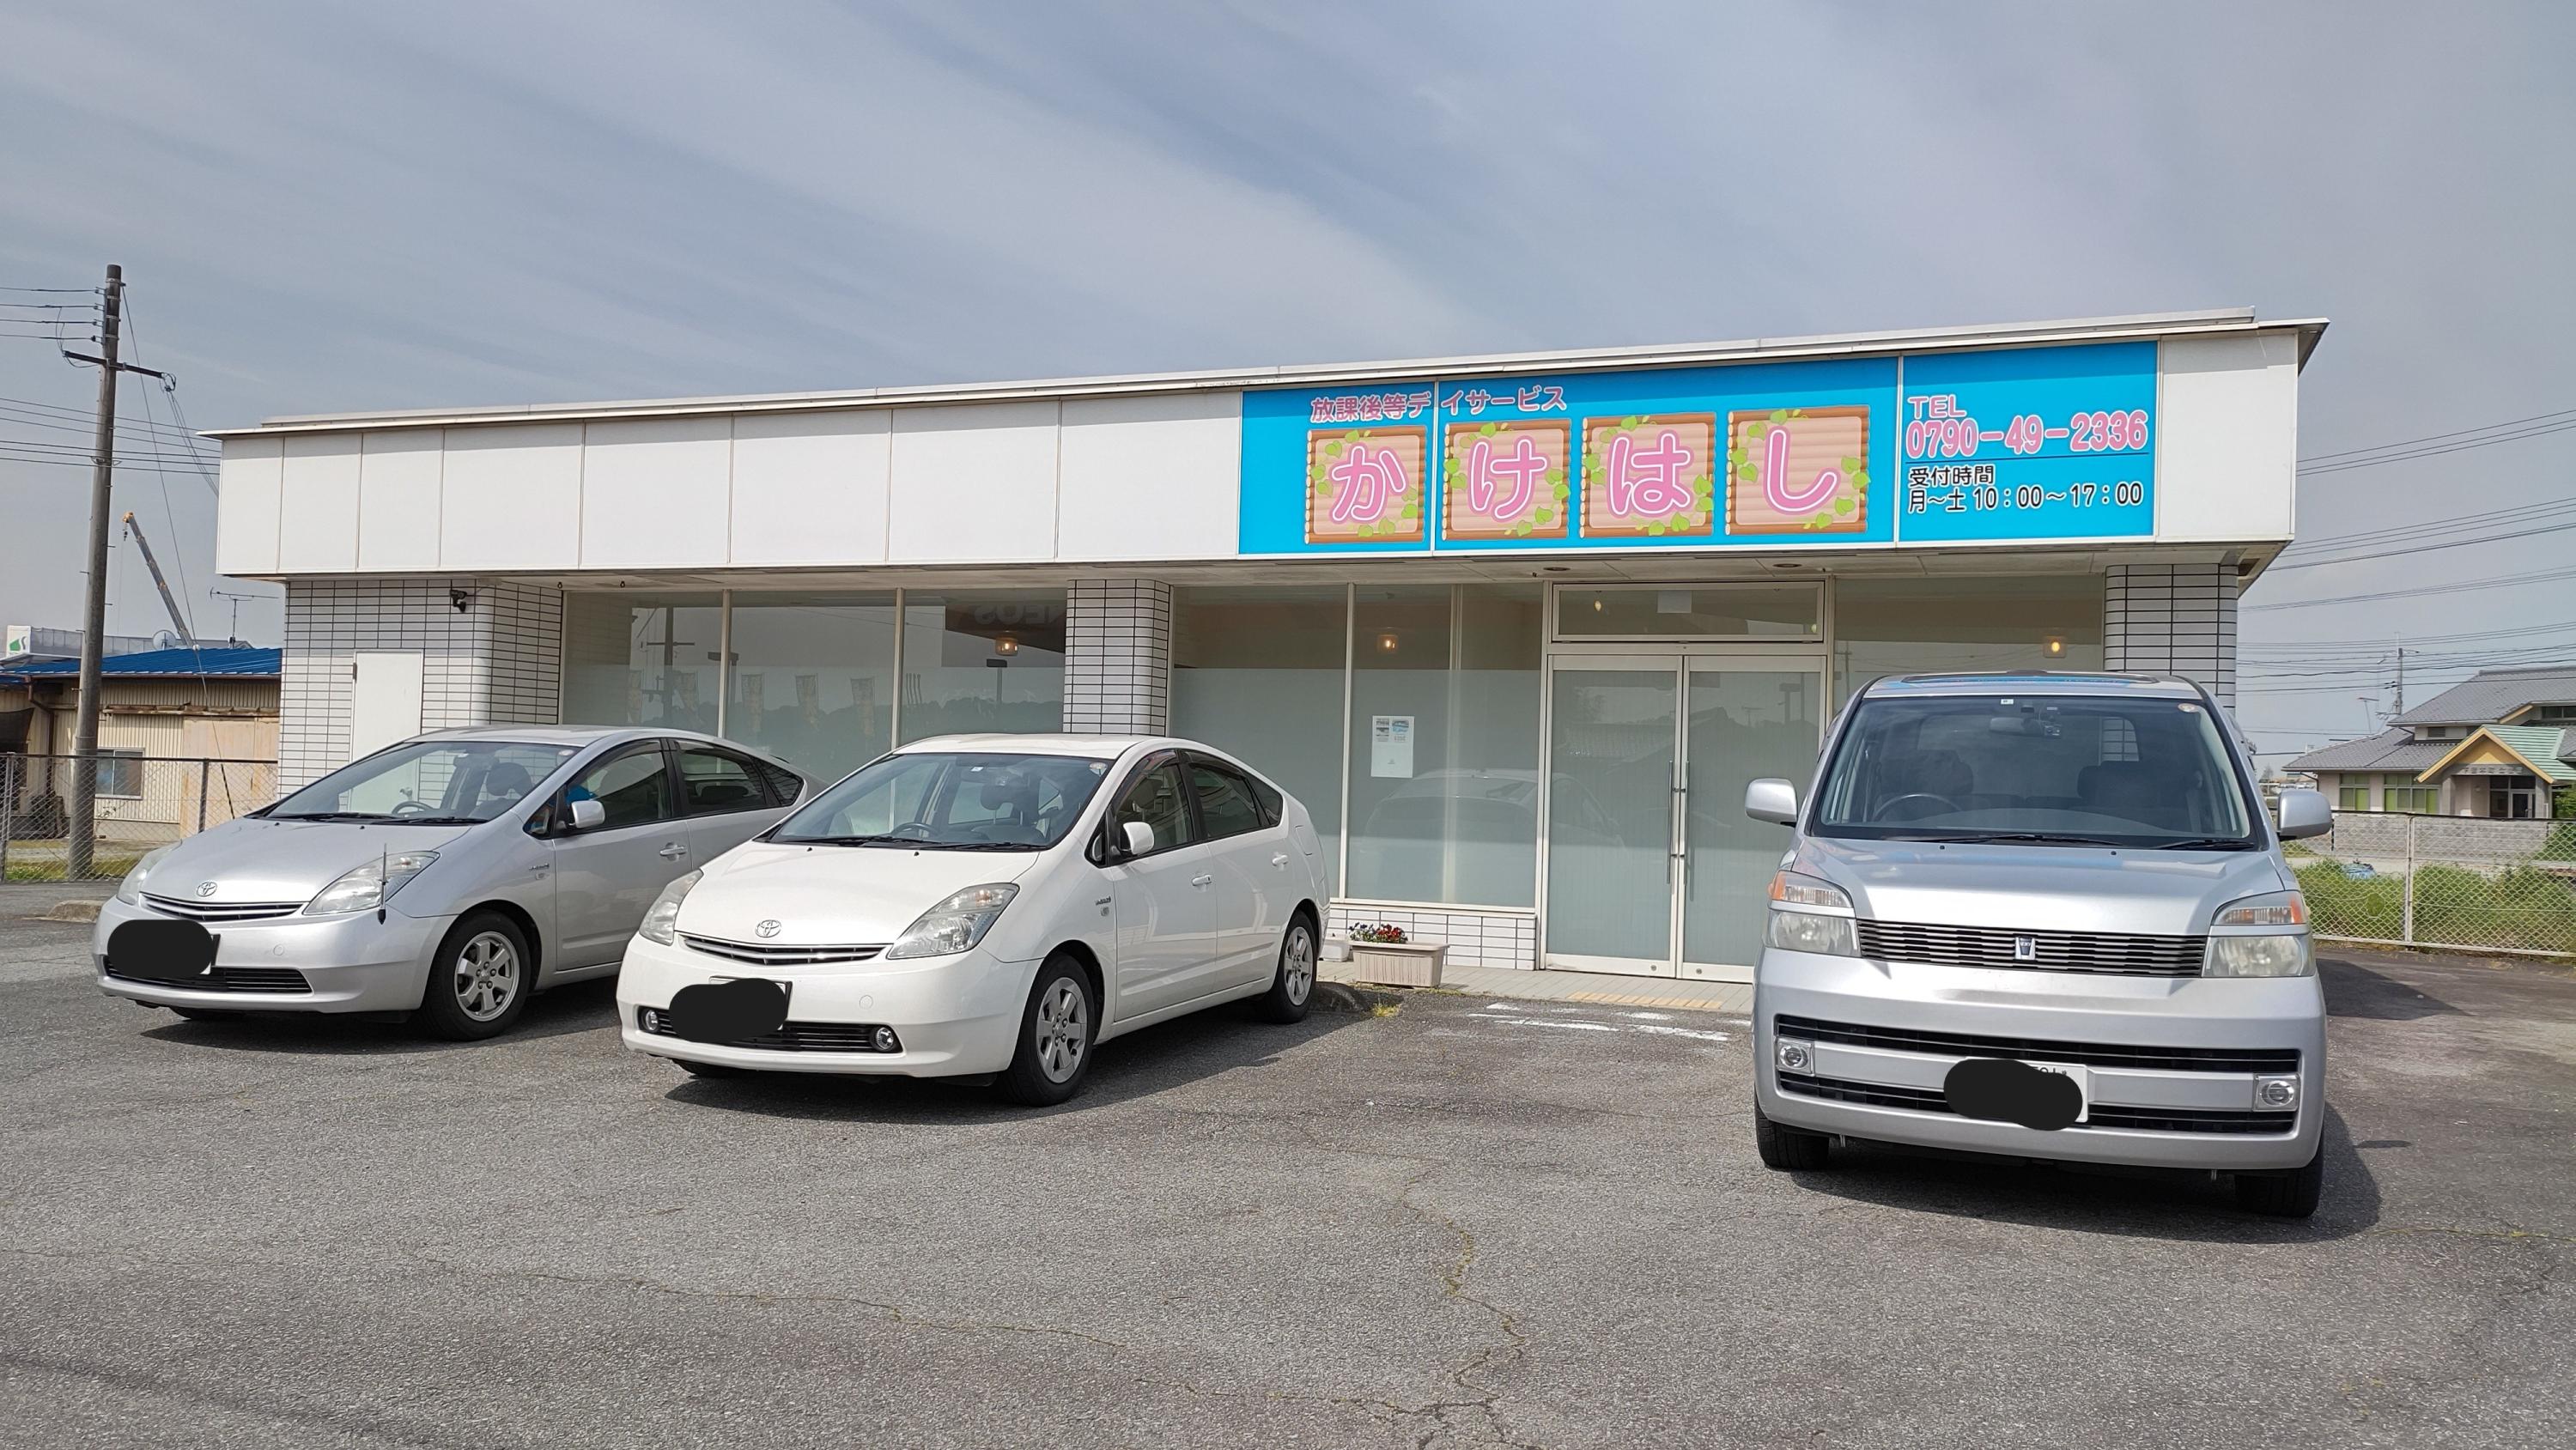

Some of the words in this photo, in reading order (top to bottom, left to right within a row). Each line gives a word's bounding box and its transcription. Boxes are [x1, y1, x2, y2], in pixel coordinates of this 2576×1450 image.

[1310, 386, 1567, 423] 放課後等デイサービス
[1907, 394, 1967, 420] TEL
[1905, 410, 2148, 458] 0790-49-2336
[1329, 428, 1840, 523] かけはし
[1909, 464, 1995, 488] 受付時間
